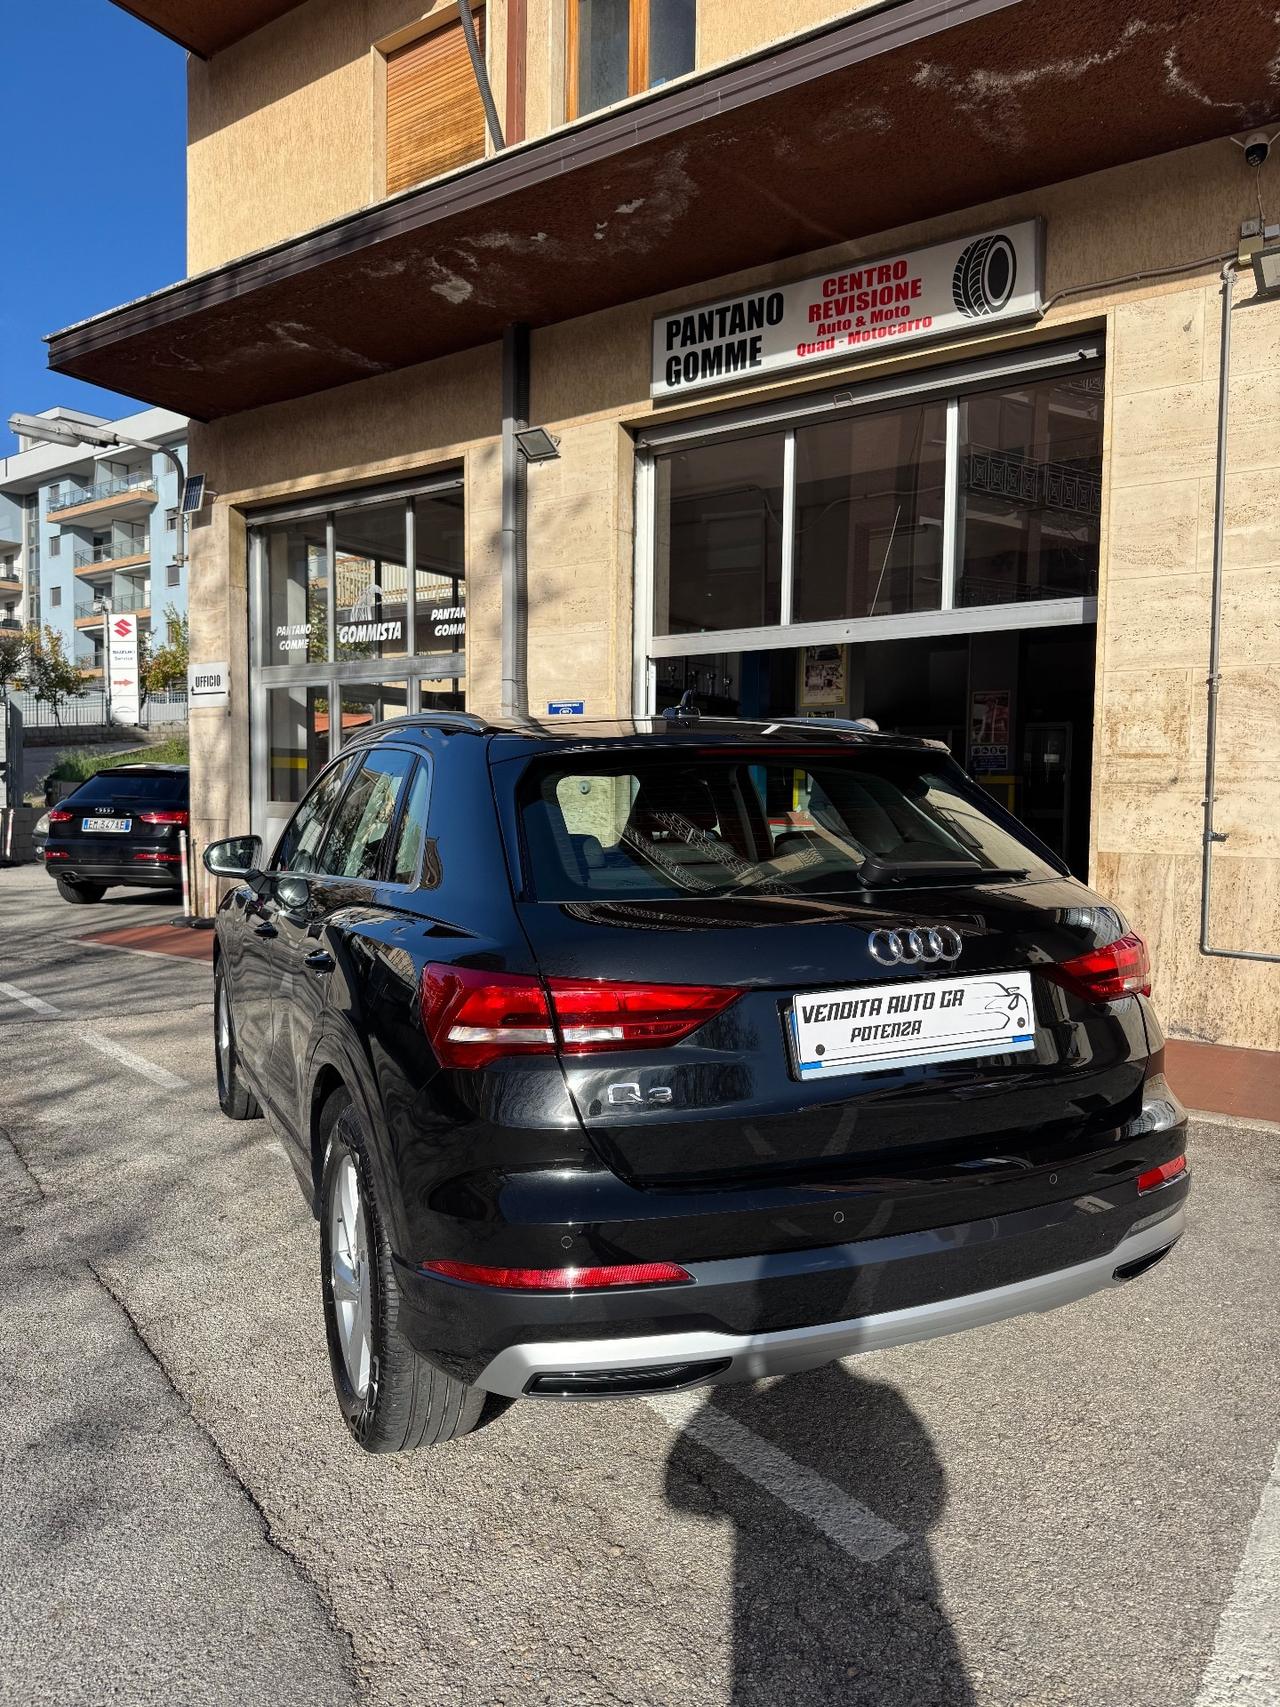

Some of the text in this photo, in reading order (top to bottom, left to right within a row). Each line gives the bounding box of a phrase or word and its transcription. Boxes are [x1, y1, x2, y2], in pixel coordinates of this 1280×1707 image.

[822, 260, 908, 298] CENTRO
[808, 278, 922, 323] REVISIONE
[666, 292, 784, 352] PANTANO
[817, 305, 910, 336] Auto & Moto
[796, 336, 835, 357] Quad
[847, 316, 933, 345] Motocarro
[665, 335, 763, 387] GOMME
[276, 623, 312, 636] PANTANO
[279, 638, 310, 651] GOMME
[339, 621, 402, 644] GOMMISTA
[195, 674, 221, 688] UFFICIO
[801, 997, 883, 1024] VENDITA
[887, 992, 936, 1015] AUTO
[850, 1019, 923, 1043] POTENZA
[607, 1082, 673, 1105] Q3
